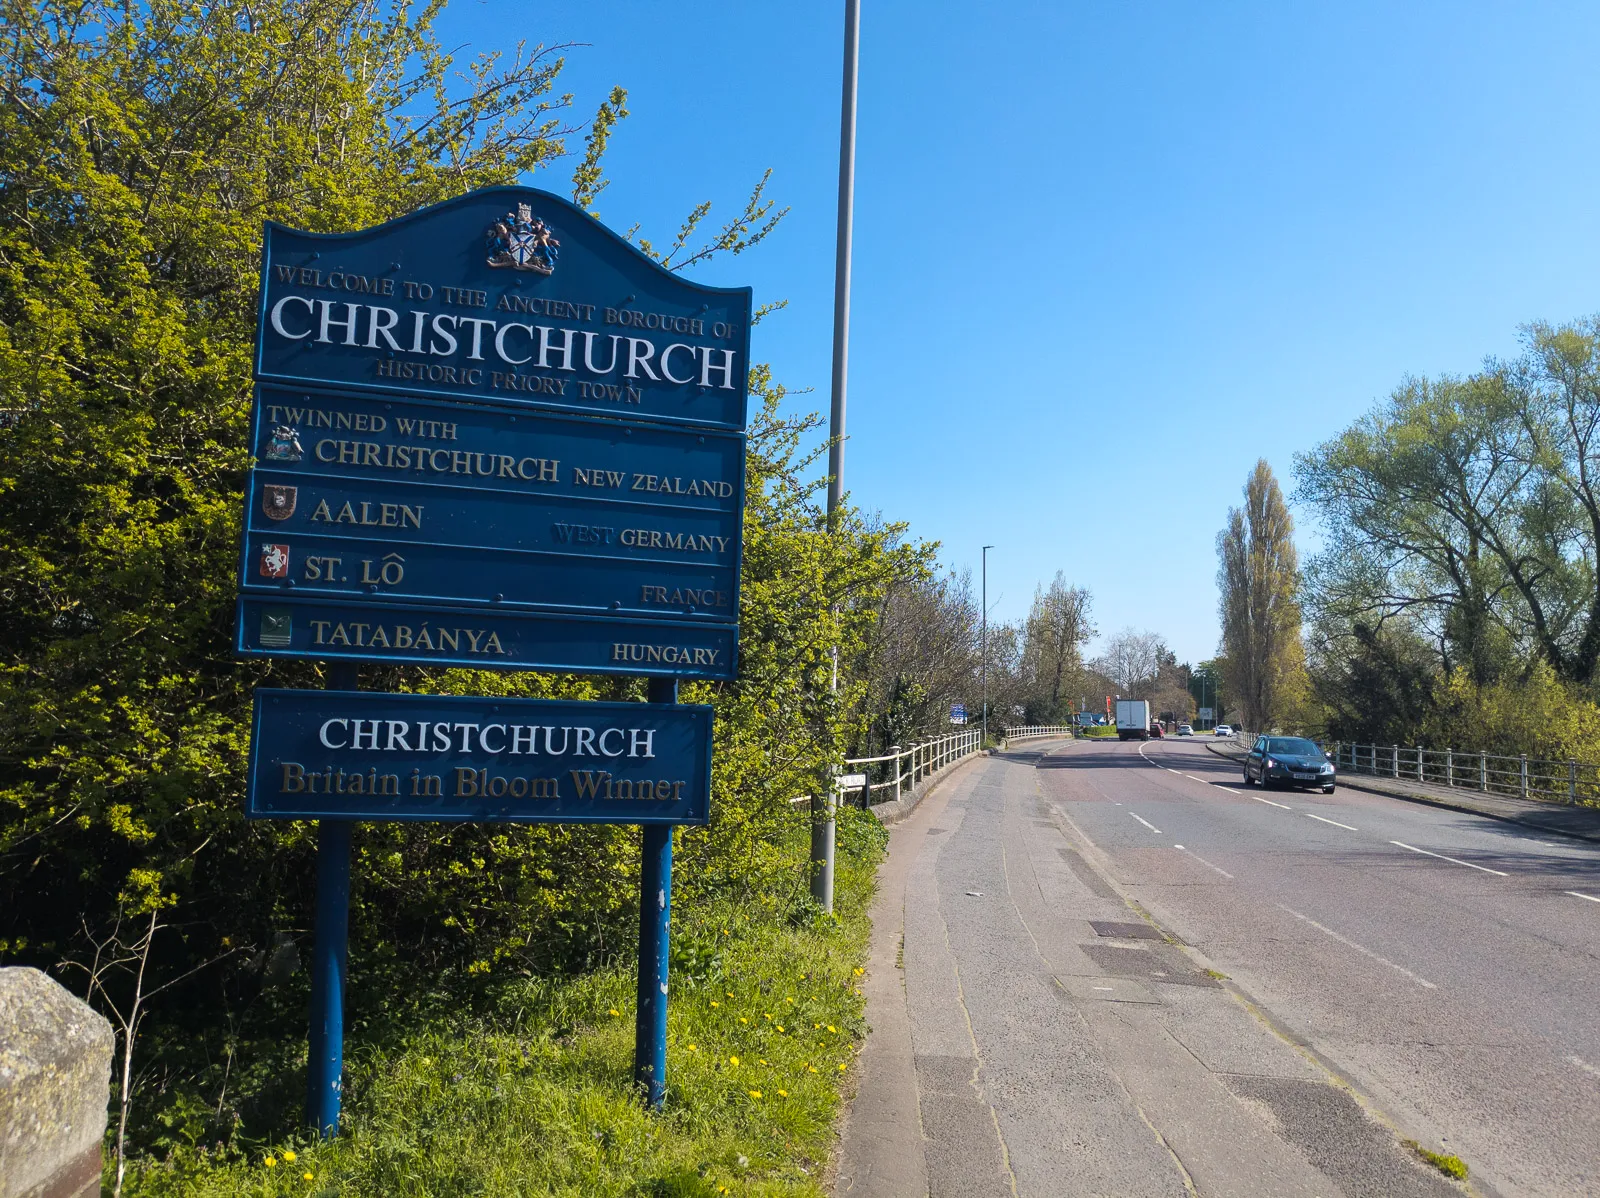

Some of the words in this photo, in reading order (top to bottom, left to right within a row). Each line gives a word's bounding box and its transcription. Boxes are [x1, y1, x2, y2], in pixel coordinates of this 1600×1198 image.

[275, 264, 395, 296] WELCOME
[404, 282, 433, 301] TO
[441, 286, 487, 308] THE
[497, 293, 595, 322] ANCIENT
[604, 308, 704, 336] BOROUGH
[711, 321, 737, 339] OF
[271, 295, 736, 390] CHRISTCHURCH
[375, 358, 482, 386] HISTORIC
[491, 371, 570, 397] PRIORY
[578, 381, 642, 405] TOWN
[267, 404, 386, 433] TWINNED
[396, 417, 458, 441] WITH
[315, 438, 560, 483] CHRISTCHURCH
[574, 467, 626, 490] NEW
[631, 473, 733, 499] ZEALAND
[310, 498, 425, 530] AALEN
[553, 522, 614, 544] WEST
[620, 528, 731, 554] GERMANY
[305, 556, 347, 583] ST.
[361, 552, 405, 586] LÔ
[641, 584, 727, 608] FRANCE
[310, 619, 505, 655] TATABÁNYA
[612, 643, 720, 667] HUNGARY
[319, 718, 656, 758] CHRISTCHURCH
[280, 762, 400, 796] Britain
[410, 768, 443, 797] in
[453, 766, 561, 799] Bloom
[569, 769, 686, 801] Winner
